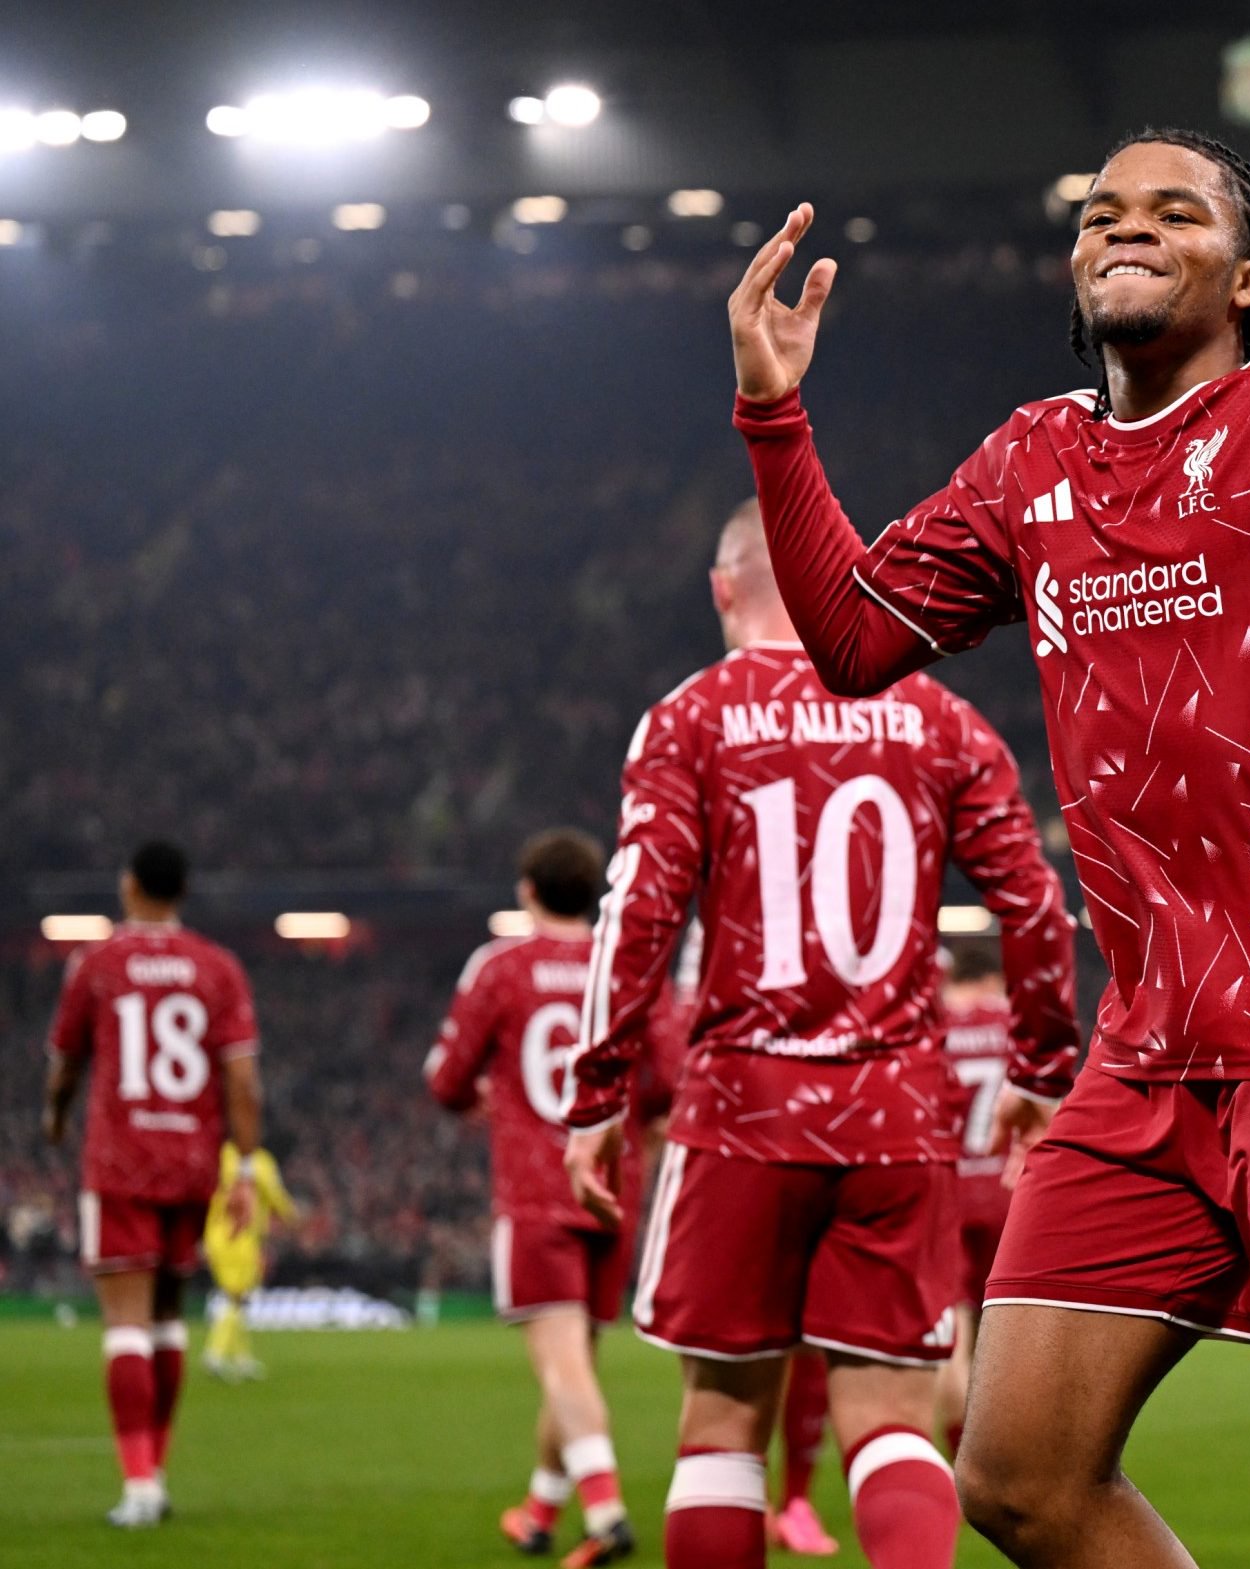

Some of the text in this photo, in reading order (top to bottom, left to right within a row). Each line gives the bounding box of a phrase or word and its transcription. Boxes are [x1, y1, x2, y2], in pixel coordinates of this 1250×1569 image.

[1178, 492, 1221, 520] L.F.C.
[1069, 552, 1208, 604] standard
[1072, 584, 1224, 636] chartered
[721, 699, 926, 748] MAC ALLISTER
[739, 774, 918, 991] 10
[113, 990, 210, 1103] 18
[520, 1000, 581, 1125] 6
[955, 1057, 1008, 1156] 7
